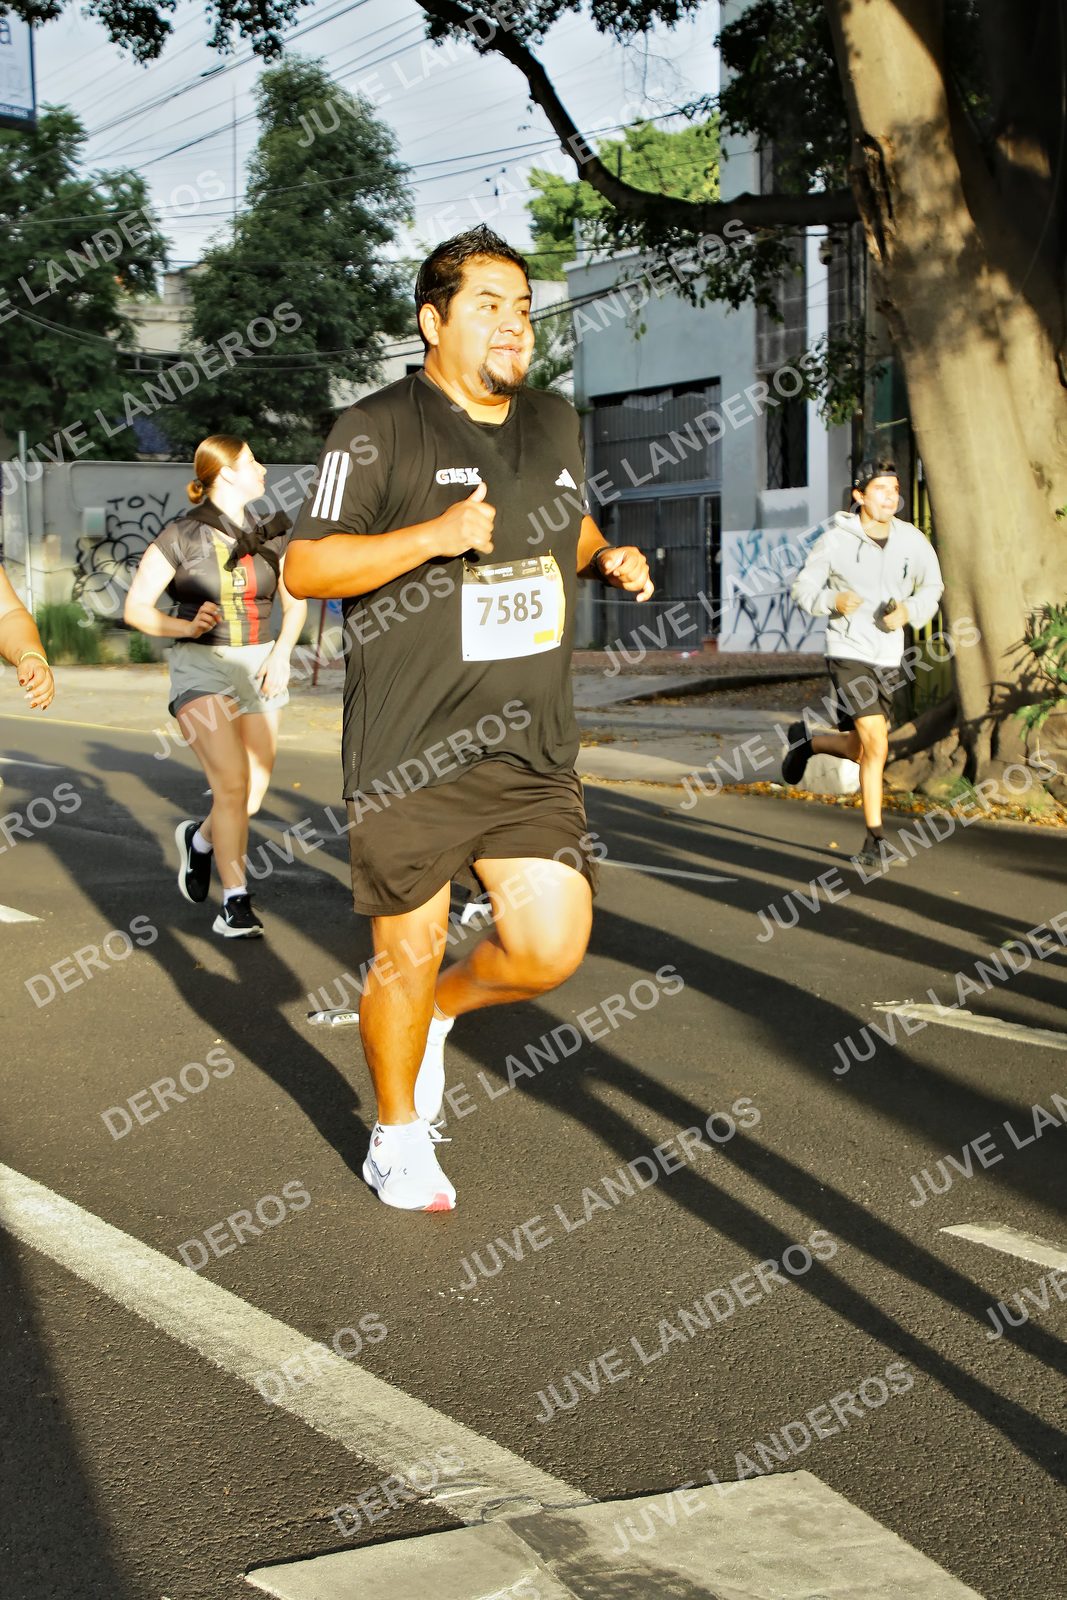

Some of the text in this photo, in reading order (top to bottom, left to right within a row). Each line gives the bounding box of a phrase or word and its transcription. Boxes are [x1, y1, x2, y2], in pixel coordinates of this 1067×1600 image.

[436, 467, 482, 485] G15K
[106, 492, 170, 517] TOY
[476, 589, 544, 626] 7585
